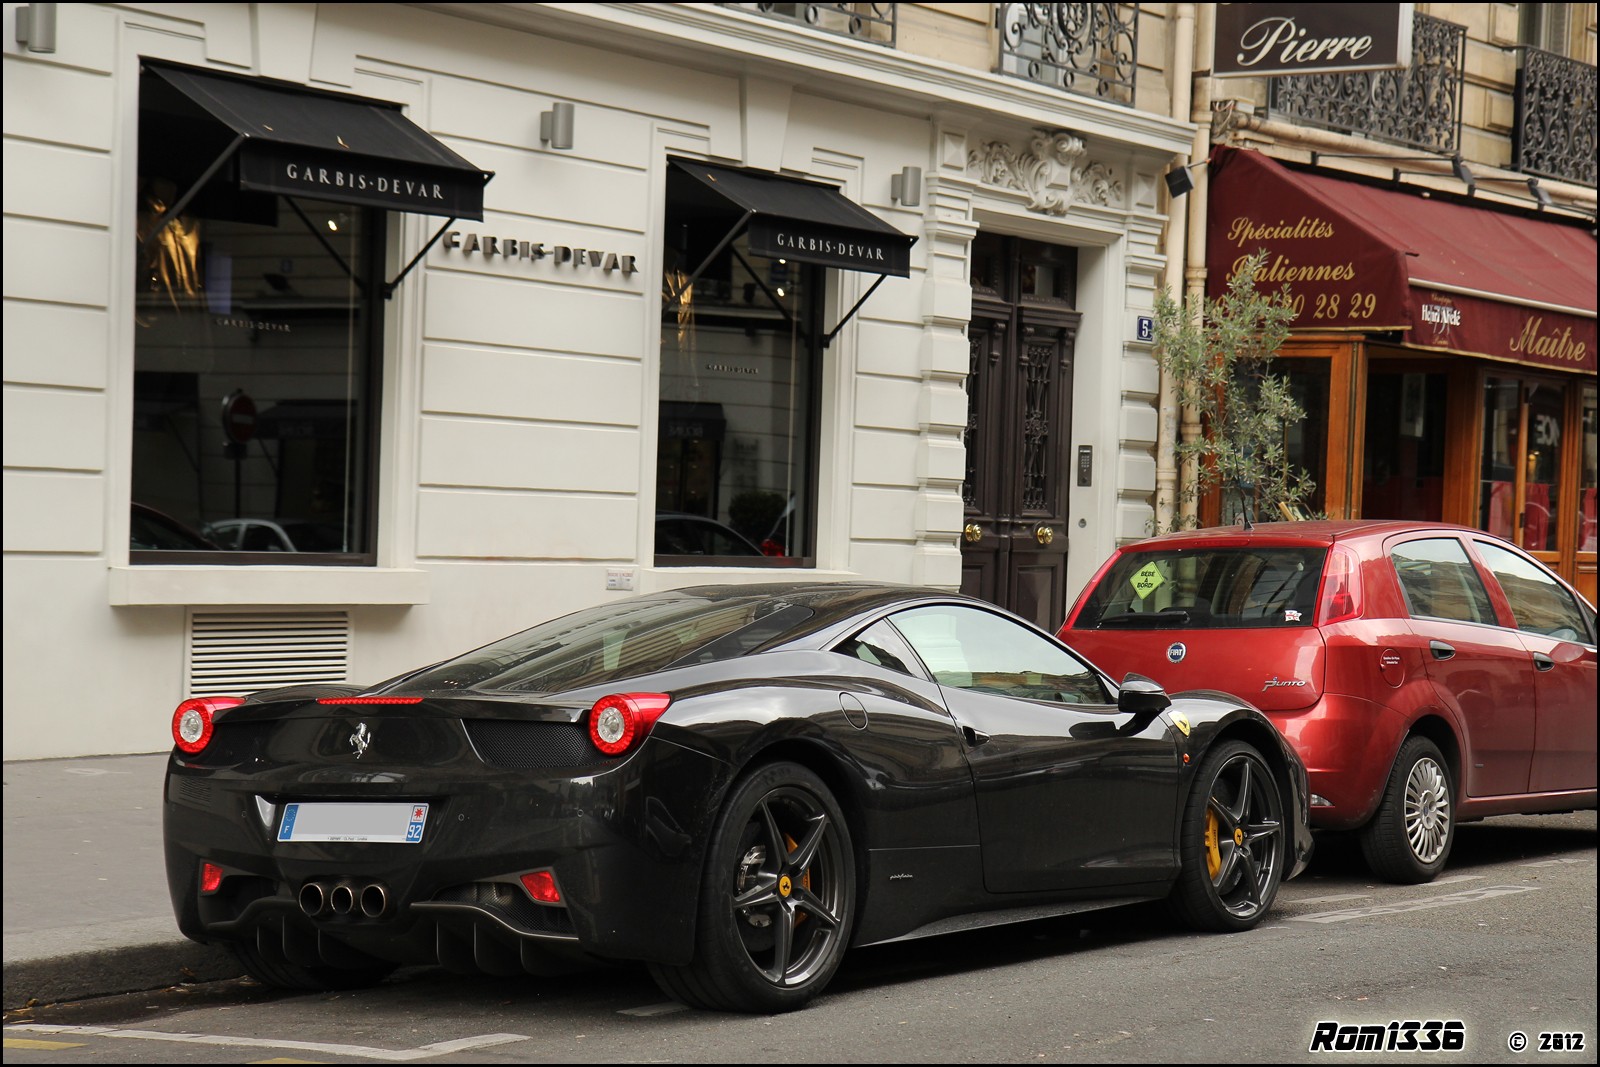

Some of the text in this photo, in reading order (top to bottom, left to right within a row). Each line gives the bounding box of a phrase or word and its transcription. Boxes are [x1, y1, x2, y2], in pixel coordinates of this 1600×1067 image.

[1236, 16, 1373, 66] Pierre
[1227, 216, 1335, 248] Spécialités
[1313, 293, 1340, 319] 28
[1348, 293, 1376, 319] 29
[1142, 319, 1149, 337] 5
[1509, 315, 1586, 362] Maître
[1169, 648, 1183, 656] FIAT
[283, 825, 290, 834] F
[407, 824, 422, 839] 92
